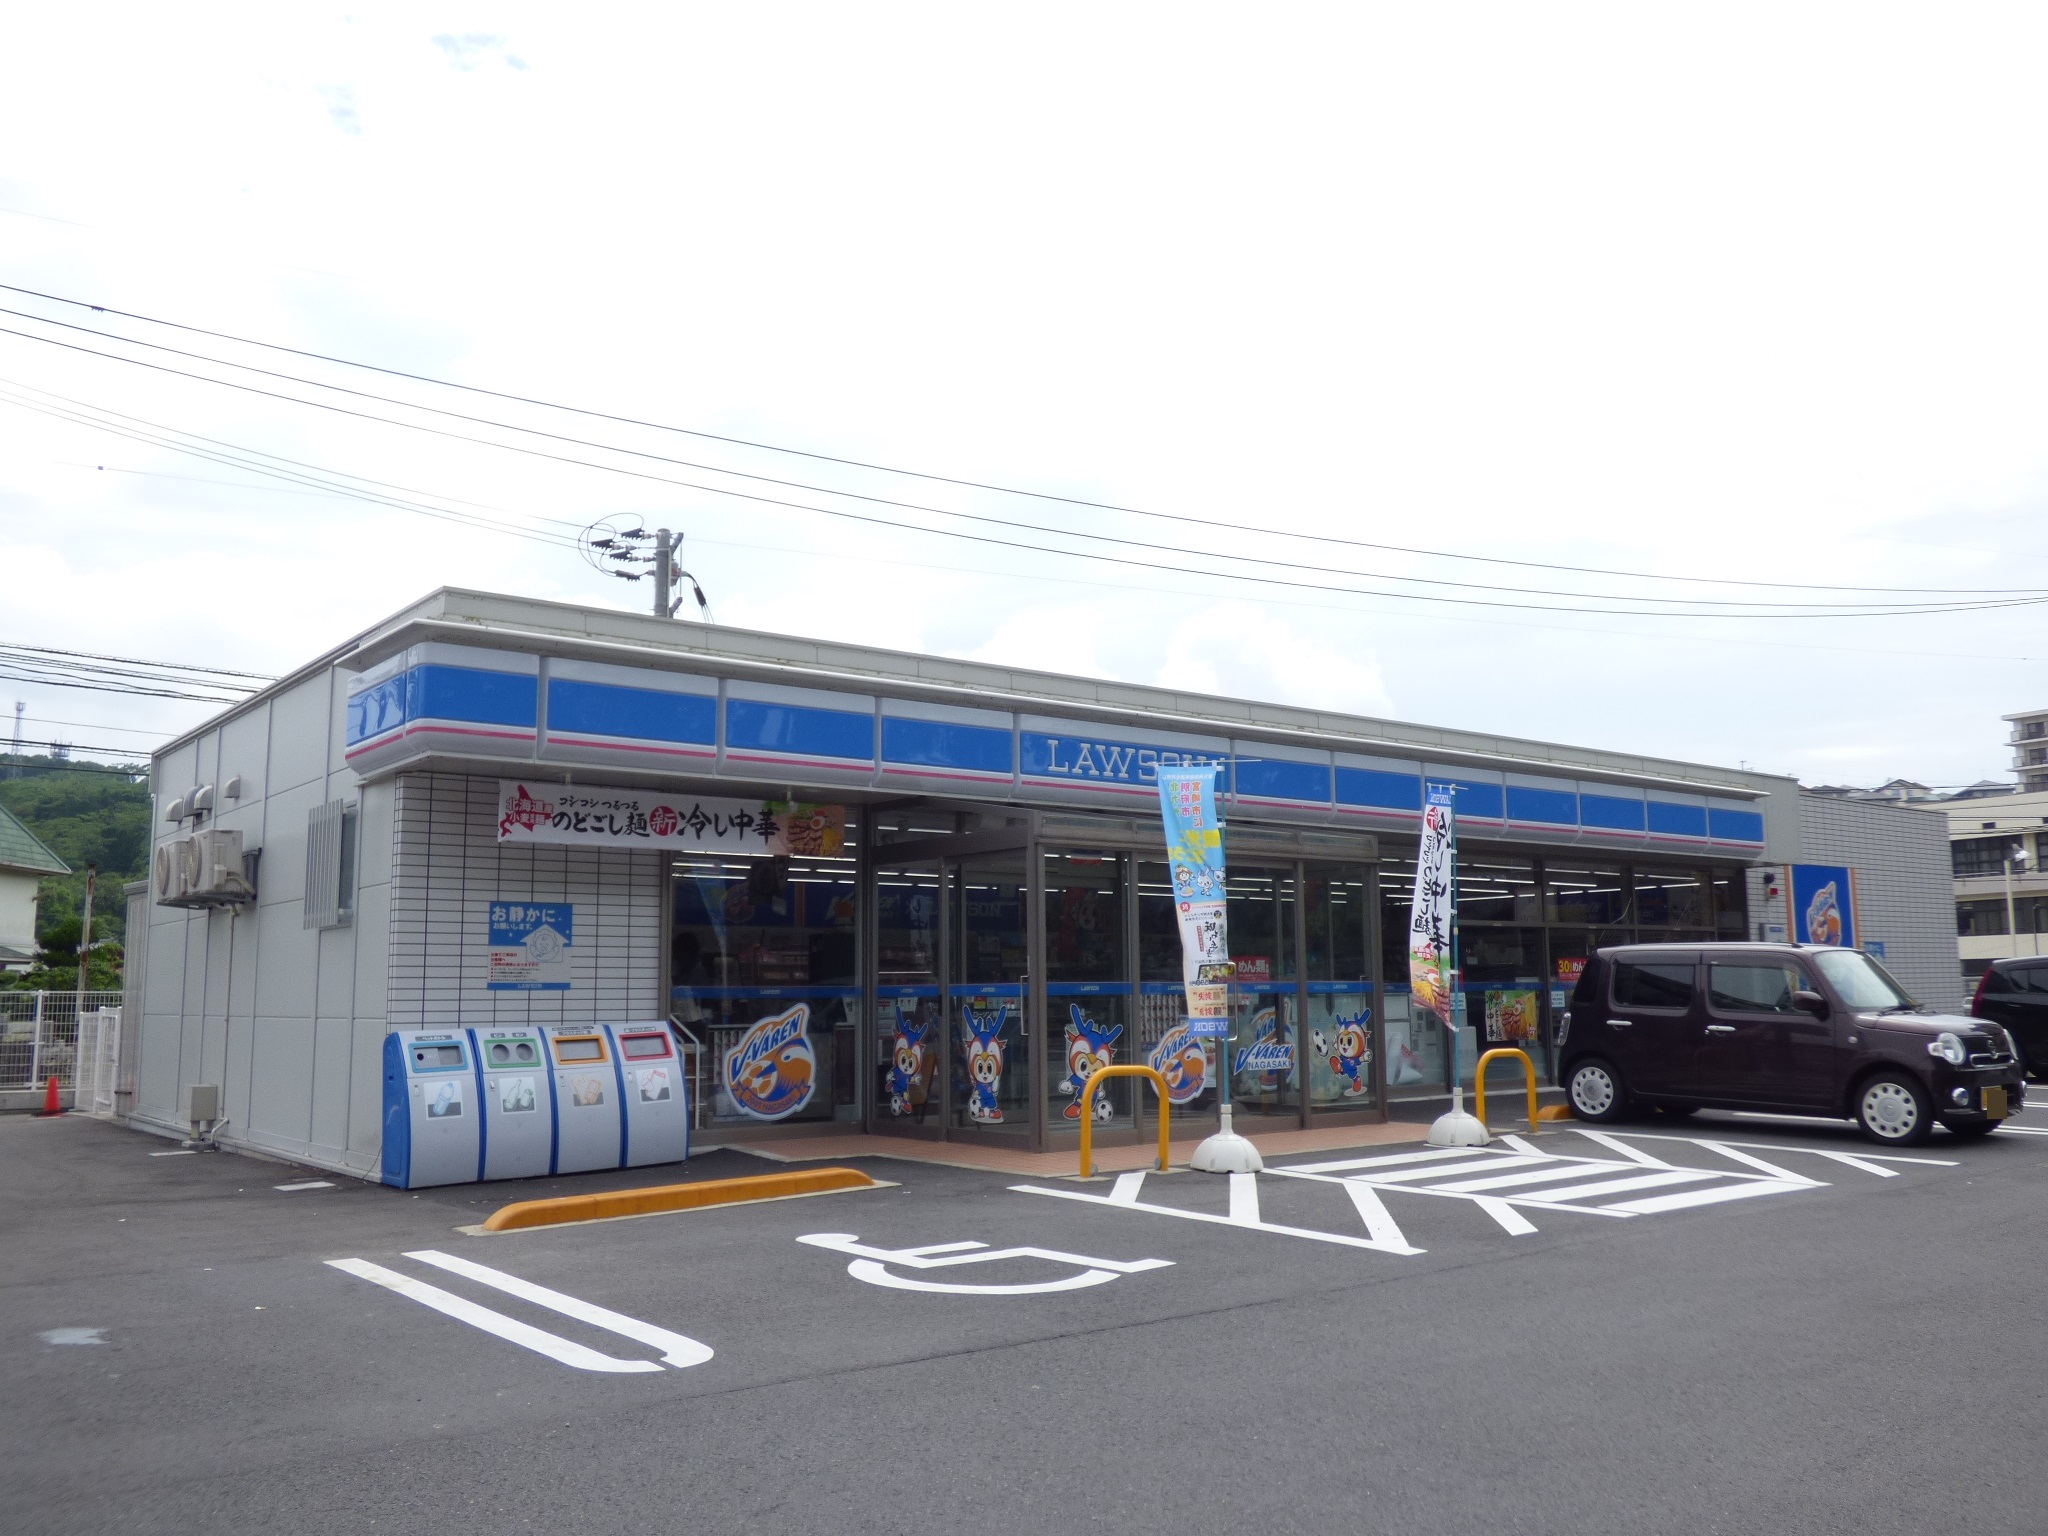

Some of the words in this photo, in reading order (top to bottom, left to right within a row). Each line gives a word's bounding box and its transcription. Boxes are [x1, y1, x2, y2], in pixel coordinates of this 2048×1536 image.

[559, 795, 599, 808] コシコシ
[553, 811, 650, 837] のどごし麺
[678, 803, 781, 845] 冷し中華
[1248, 1059, 1292, 1070] NAGASAKI
